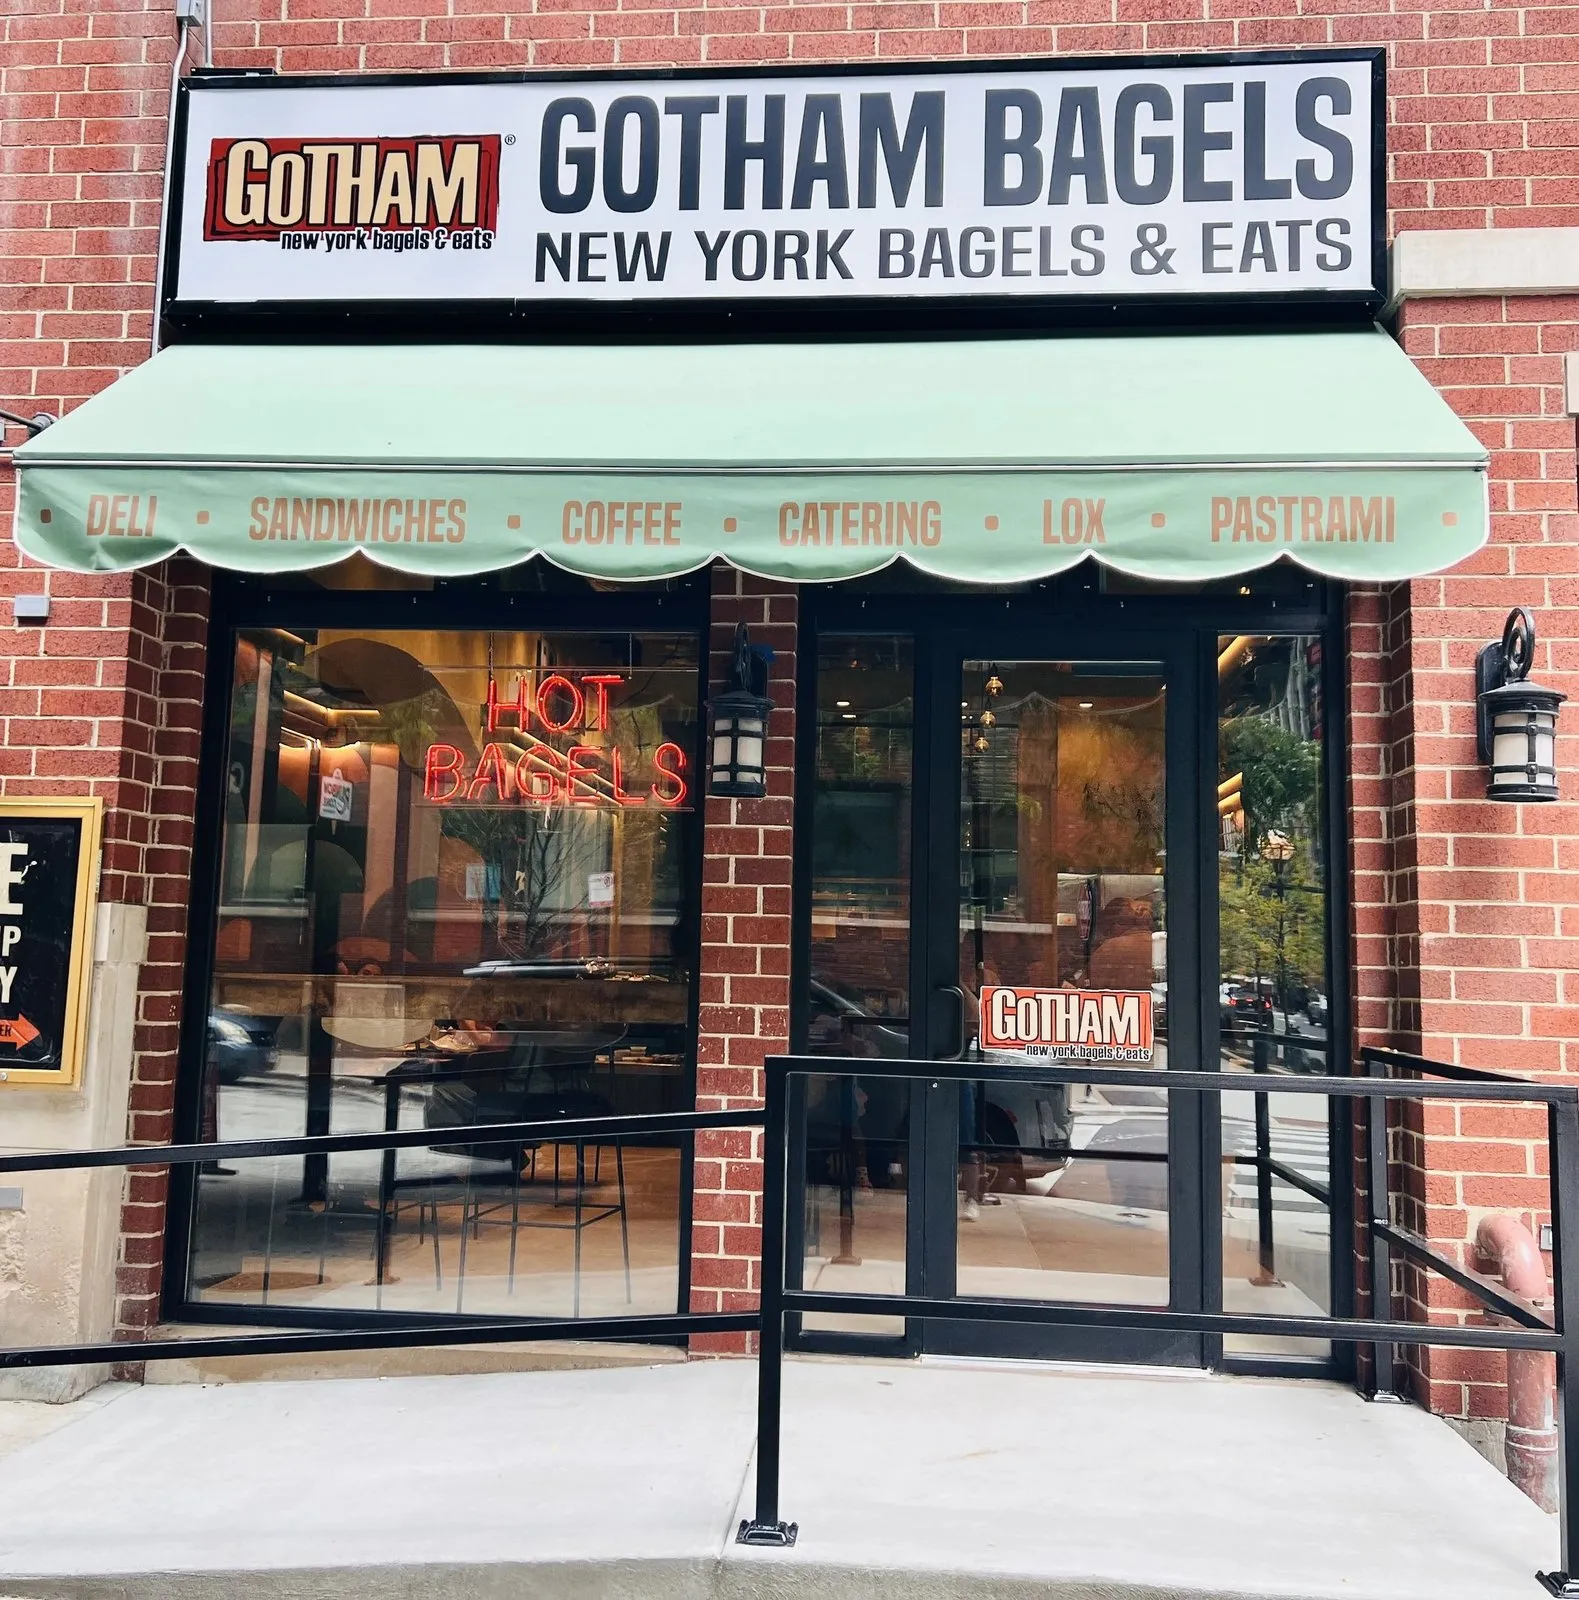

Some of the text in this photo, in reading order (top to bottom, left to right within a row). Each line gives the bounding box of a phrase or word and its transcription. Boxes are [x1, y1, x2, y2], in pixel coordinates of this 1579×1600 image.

[540, 76, 1354, 214] GOTHAM BAGELS
[222, 138, 482, 227] GOTHAM
[281, 229, 493, 253] new york bagels & eats
[535, 217, 1353, 283] NEW YORK BAGELS & EATS
[86, 495, 1396, 547] DELI SANDWICHES COFFEE CATERING LOX PASTRAMI
[487, 674, 624, 732] HOT
[424, 742, 688, 806] BAGELS
[991, 988, 1141, 1045] GOTHAM
[1026, 1044, 1150, 1061] new york bagels & eats
